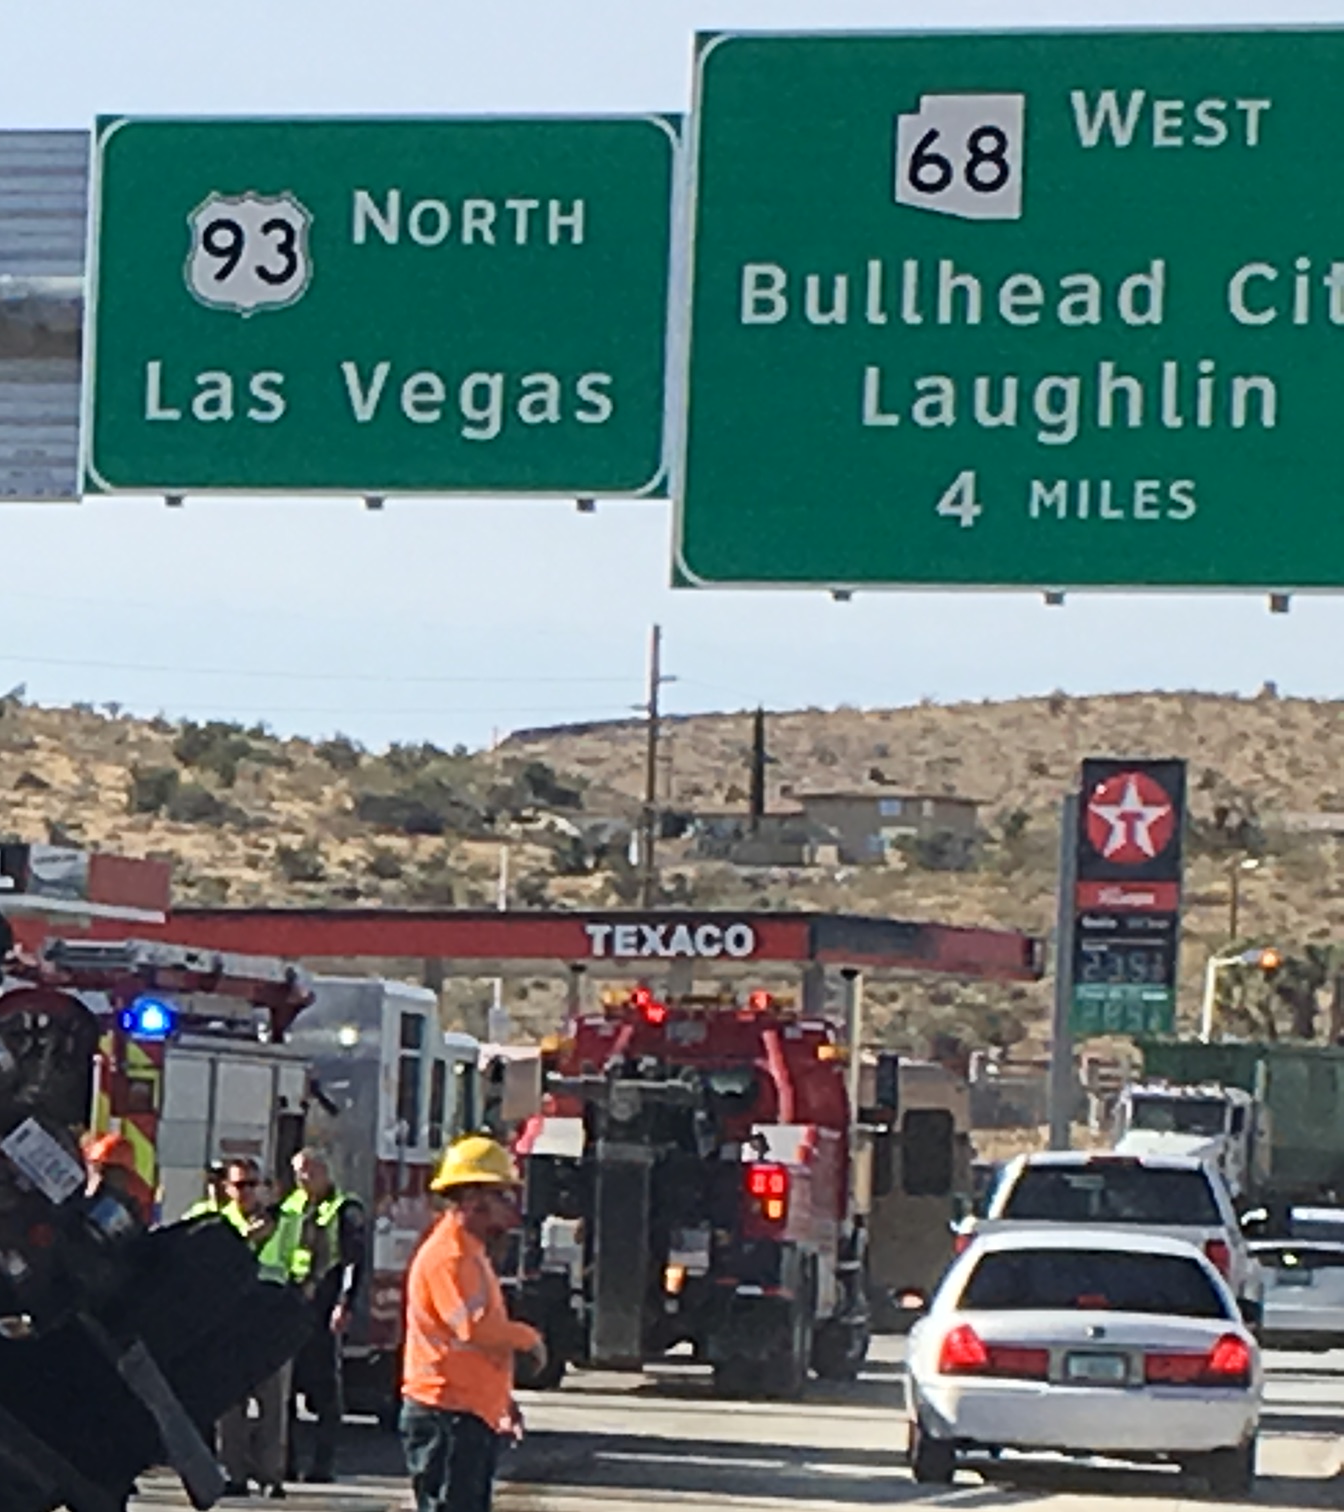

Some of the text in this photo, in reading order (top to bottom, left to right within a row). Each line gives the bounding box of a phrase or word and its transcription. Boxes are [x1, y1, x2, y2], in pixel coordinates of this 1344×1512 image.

[907, 90, 1271, 194] 68 WEST
[201, 189, 585, 285] 93 NORTH
[741, 256, 1344, 326] Bullhead Cit
[146, 360, 614, 441] Las Vegas
[862, 360, 1278, 445] Laughlin
[936, 470, 1197, 528] 4 MILES
[585, 923, 758, 958] TEXACO
